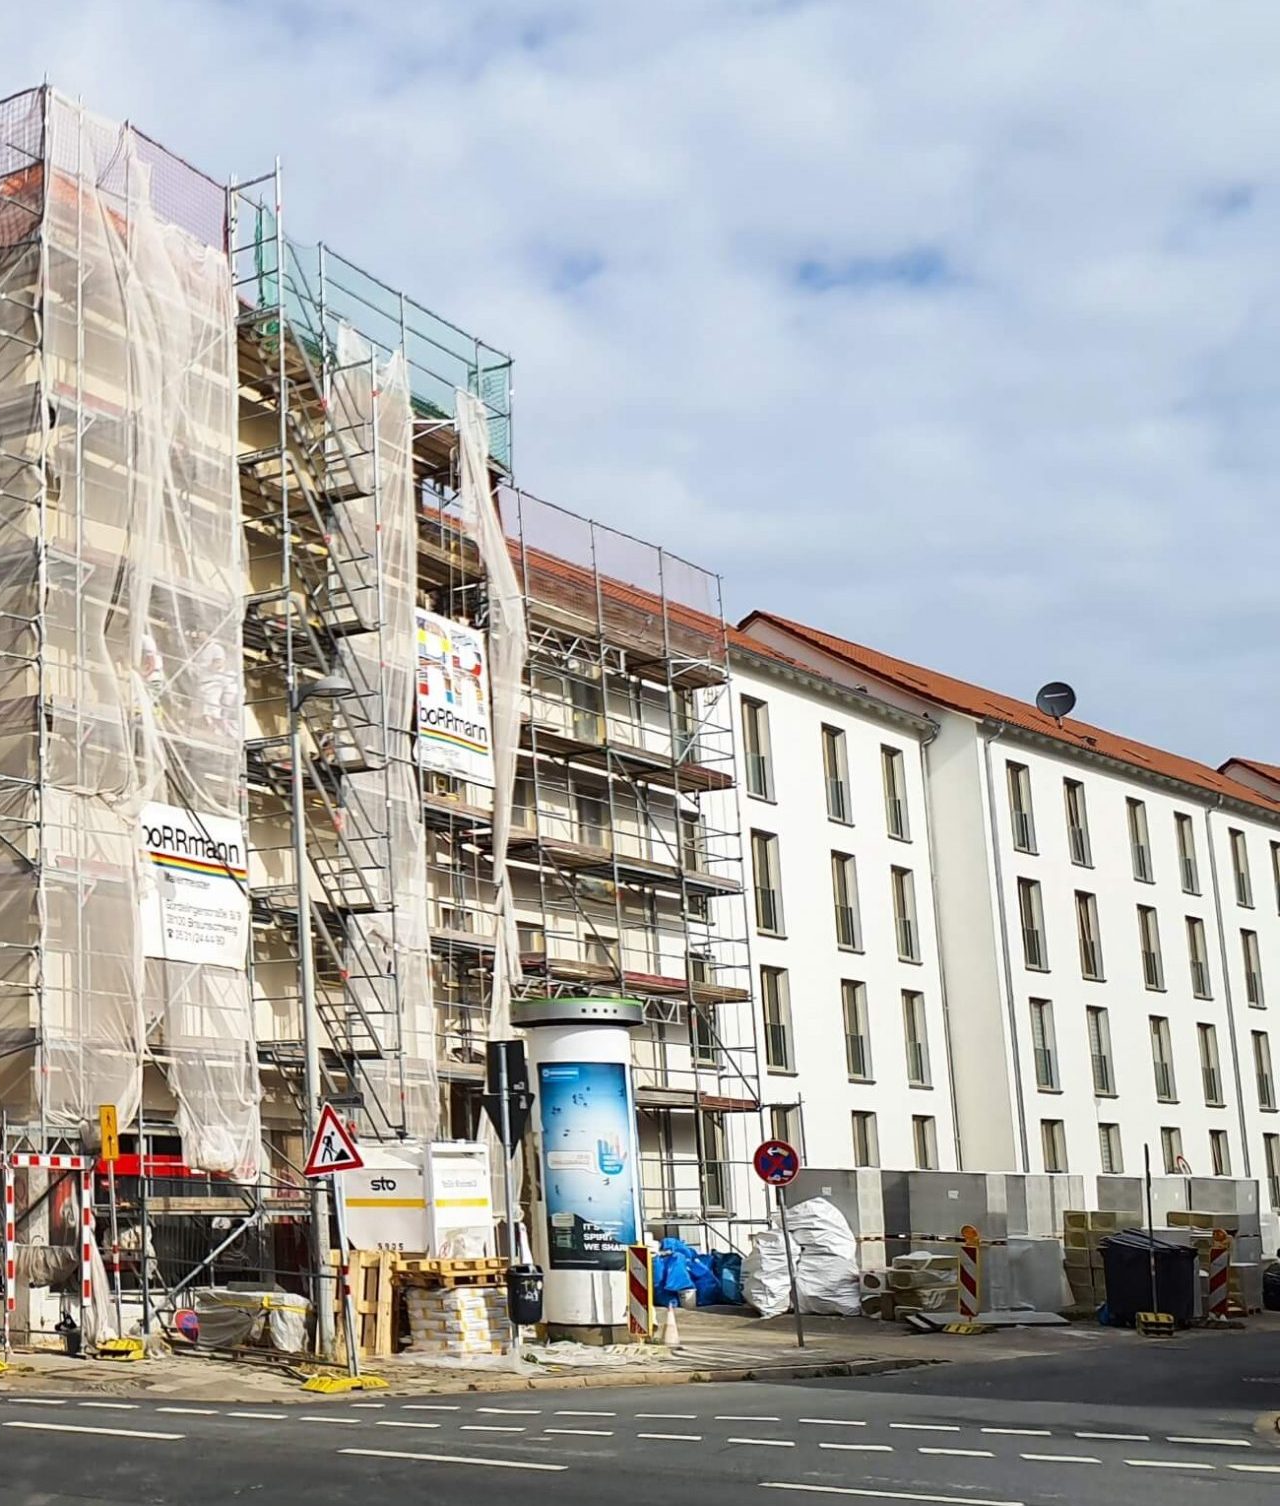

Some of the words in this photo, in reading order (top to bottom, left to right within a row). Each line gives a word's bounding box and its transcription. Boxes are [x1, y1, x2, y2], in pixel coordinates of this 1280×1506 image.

[370, 1177, 396, 1191] sto
[583, 1243, 601, 1251] WE
[602, 1243, 628, 1252] SHAR
